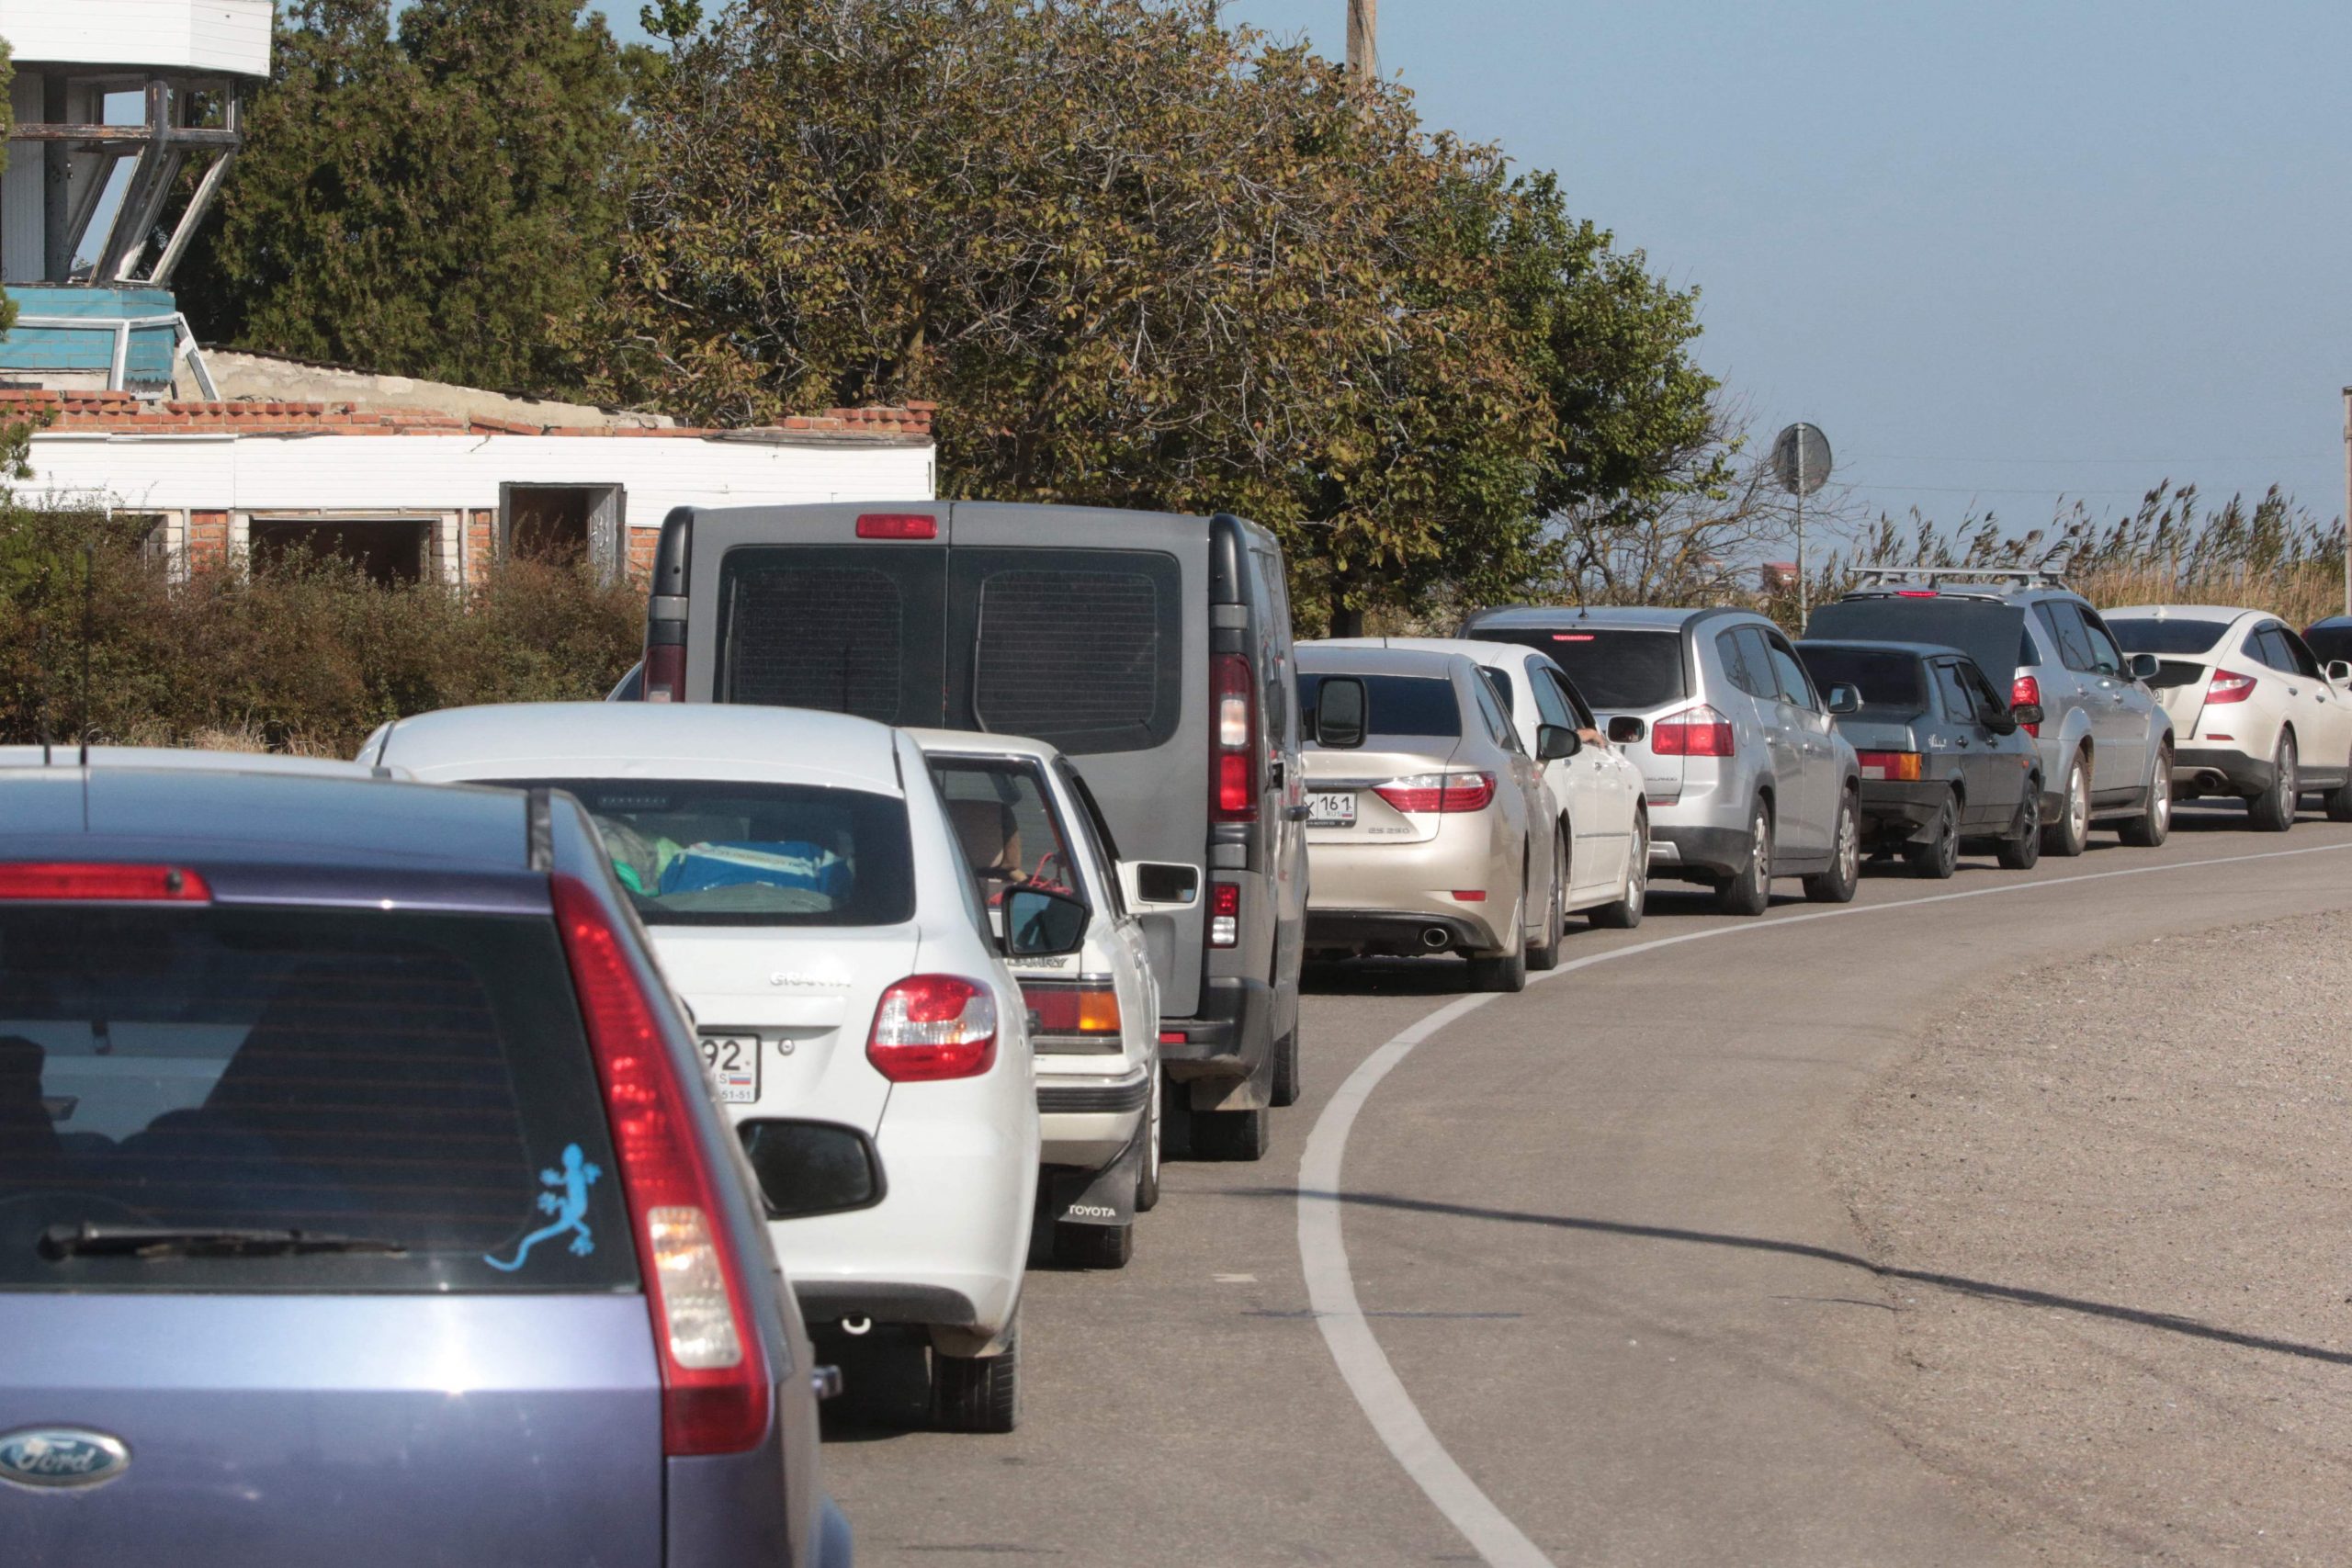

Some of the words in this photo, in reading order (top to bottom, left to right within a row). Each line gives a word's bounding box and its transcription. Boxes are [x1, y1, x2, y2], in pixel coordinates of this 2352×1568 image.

[1320, 795, 1351, 811] 161
[701, 1039, 741, 1071] 92
[1069, 1204, 1116, 1218] TOYOTA
[10, 1438, 96, 1472] Ford
